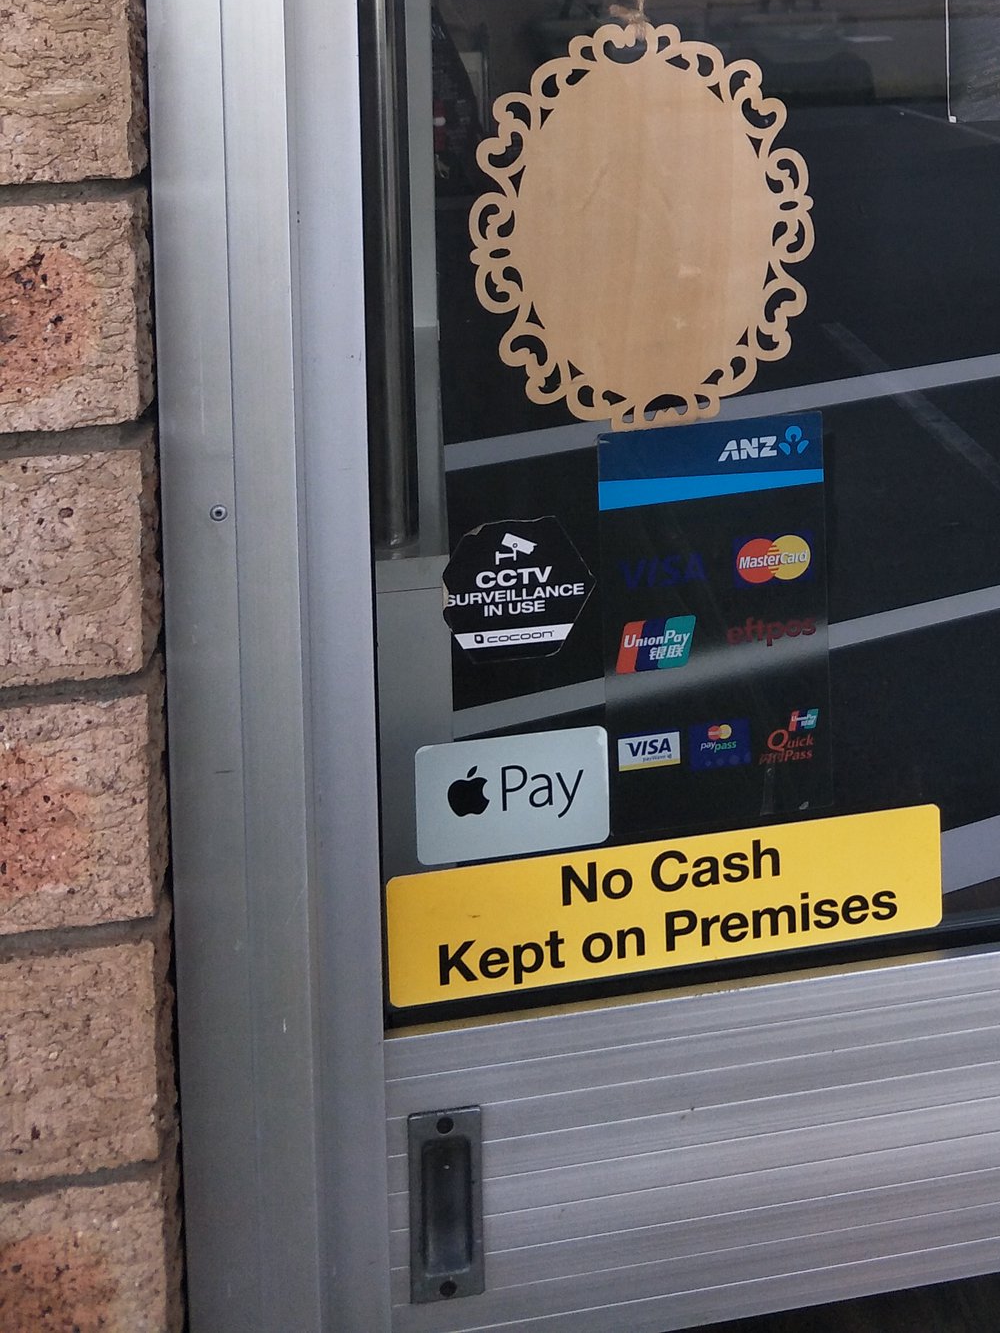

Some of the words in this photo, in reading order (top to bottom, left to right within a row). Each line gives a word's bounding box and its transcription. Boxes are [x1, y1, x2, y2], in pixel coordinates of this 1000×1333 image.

[718, 436, 777, 462] ANZ
[622, 552, 708, 589] VISA
[738, 551, 809, 570] MasterCard
[475, 566, 552, 589] CCTV
[447, 583, 585, 607] SURVEILLANCE
[484, 605, 503, 617] IN
[508, 600, 546, 615] USE
[624, 630, 691, 648] UnionPay
[726, 617, 817, 646] eftpos
[625, 738, 671, 757] VISA
[767, 729, 814, 752] Quick
[500, 764, 584, 818] Pay
[561, 865, 633, 906] No
[650, 839, 781, 894] Cash
[438, 930, 565, 986] Kept
[582, 926, 645, 964] on
[665, 889, 899, 953] Premises
